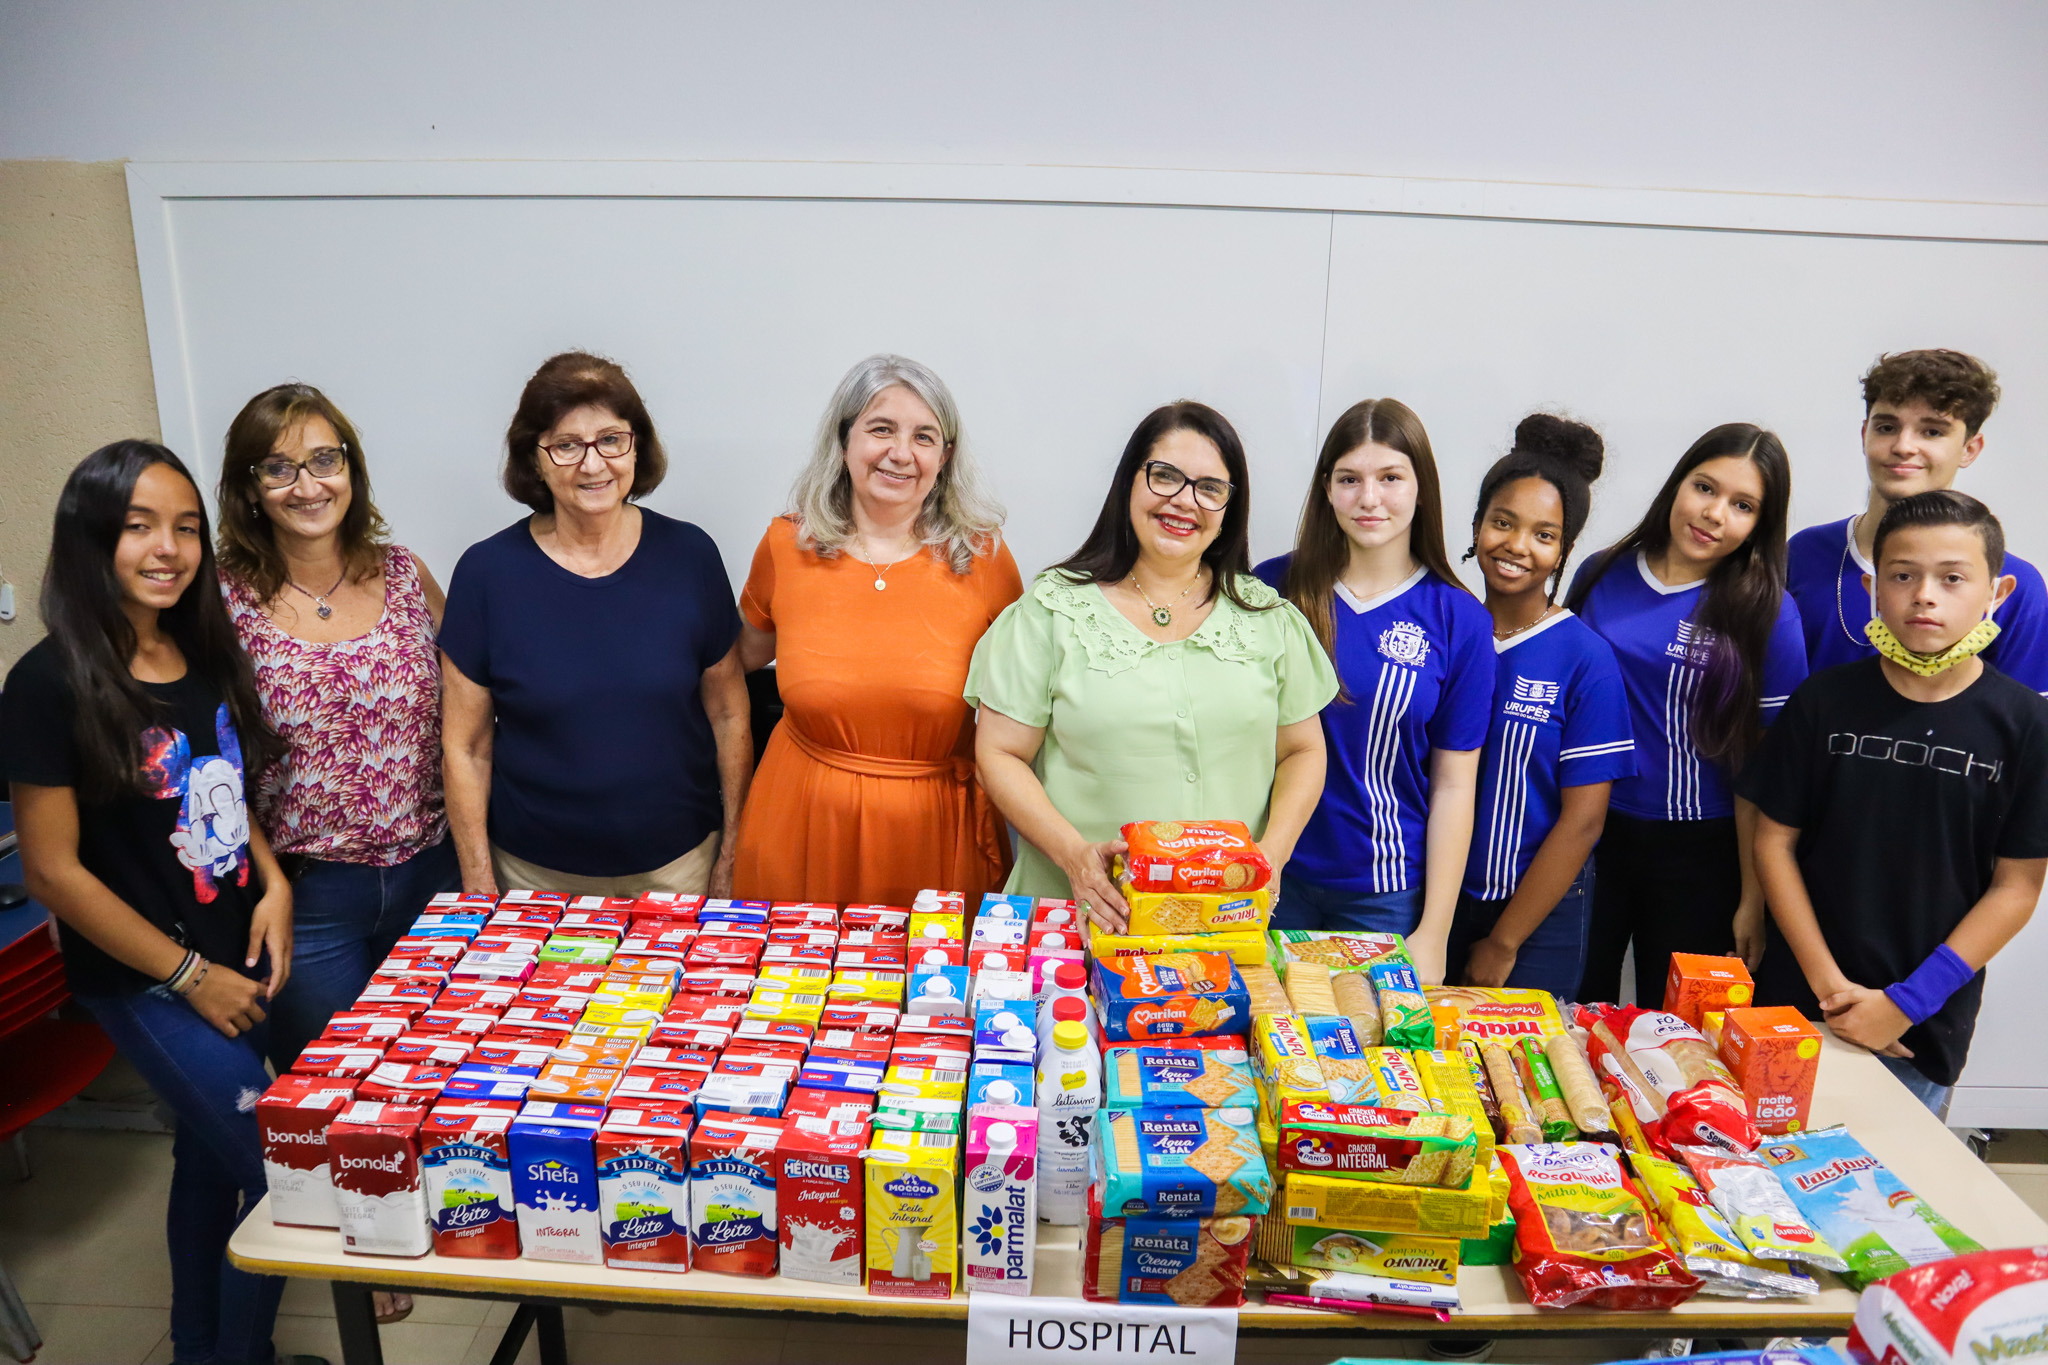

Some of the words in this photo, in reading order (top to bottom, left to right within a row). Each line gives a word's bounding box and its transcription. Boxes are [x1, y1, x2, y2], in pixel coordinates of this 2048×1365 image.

[1505, 701, 1551, 719] URUPÊS
[1157, 835, 1245, 848] Marilan
[1178, 867, 1223, 880] Marilan
[1211, 908, 1257, 924] TRIUNFO
[1344, 940, 1371, 959] STOP
[1361, 942, 1382, 955] PIT
[1400, 969, 1415, 989] Renata
[1475, 1003, 1542, 1015] Maisena
[1134, 1009, 1186, 1025] Marilan
[1273, 1017, 1307, 1056] TRIUNFO
[1339, 1028, 1356, 1054] Renata
[1730, 1029, 1744, 1048] leão
[1145, 1057, 1196, 1067] Renata
[1154, 1067, 1193, 1078] Água
[1382, 1049, 1419, 1091] TRIUNFO
[1758, 1095, 1793, 1104] matte
[393, 1105, 422, 1113] bonolat
[1756, 1104, 1796, 1118] leão
[1339, 1114, 1391, 1125] INTEGRAL
[1143, 1122, 1198, 1132] Renata
[266, 1127, 327, 1145] bonolat
[1153, 1135, 1195, 1148] Água
[436, 1148, 490, 1160] LIDER
[1348, 1144, 1376, 1153] CRACKER
[339, 1154, 403, 1173] bonolat
[1303, 1154, 1330, 1162] PANCO
[1337, 1154, 1389, 1168] INTEGRAL
[454, 1167, 468, 1175] SEU
[468, 1168, 487, 1178] LEITE
[613, 1158, 665, 1174] LIDER
[705, 1161, 758, 1178] LIDER
[784, 1160, 850, 1180] HÉRCULES
[528, 1164, 579, 1184] Shefa
[974, 1173, 1001, 1187] parmalat
[1528, 1170, 1617, 1185] ROSQUINHA
[628, 1181, 641, 1189] SEU
[642, 1181, 661, 1192] LEITE
[734, 1184, 753, 1196] LEITE
[889, 1184, 934, 1194] MOCOCA
[1537, 1187, 1577, 1201] Milho
[1580, 1185, 1616, 1199] Verde
[798, 1189, 841, 1203] Integral
[1158, 1192, 1201, 1202] Renata
[447, 1204, 491, 1226] Leite
[898, 1203, 924, 1213] Leite
[889, 1212, 933, 1223] Integral
[455, 1226, 485, 1238] integral
[536, 1226, 580, 1237] INTEGRAL
[618, 1217, 664, 1238] Leite
[707, 1220, 753, 1242] Leite
[1005, 1185, 1028, 1280] parmalat
[1775, 1227, 1815, 1240] Romano
[627, 1239, 657, 1251] integral
[714, 1242, 746, 1254] integral
[1134, 1237, 1189, 1251] Renata
[1137, 1252, 1183, 1267] Cream
[1383, 1257, 1449, 1272] TRIUNFO
[973, 1271, 997, 1279] INTEGRAL
[1141, 1266, 1179, 1275] CRACKER
[1009, 1319, 1196, 1355] HOSPITAL
